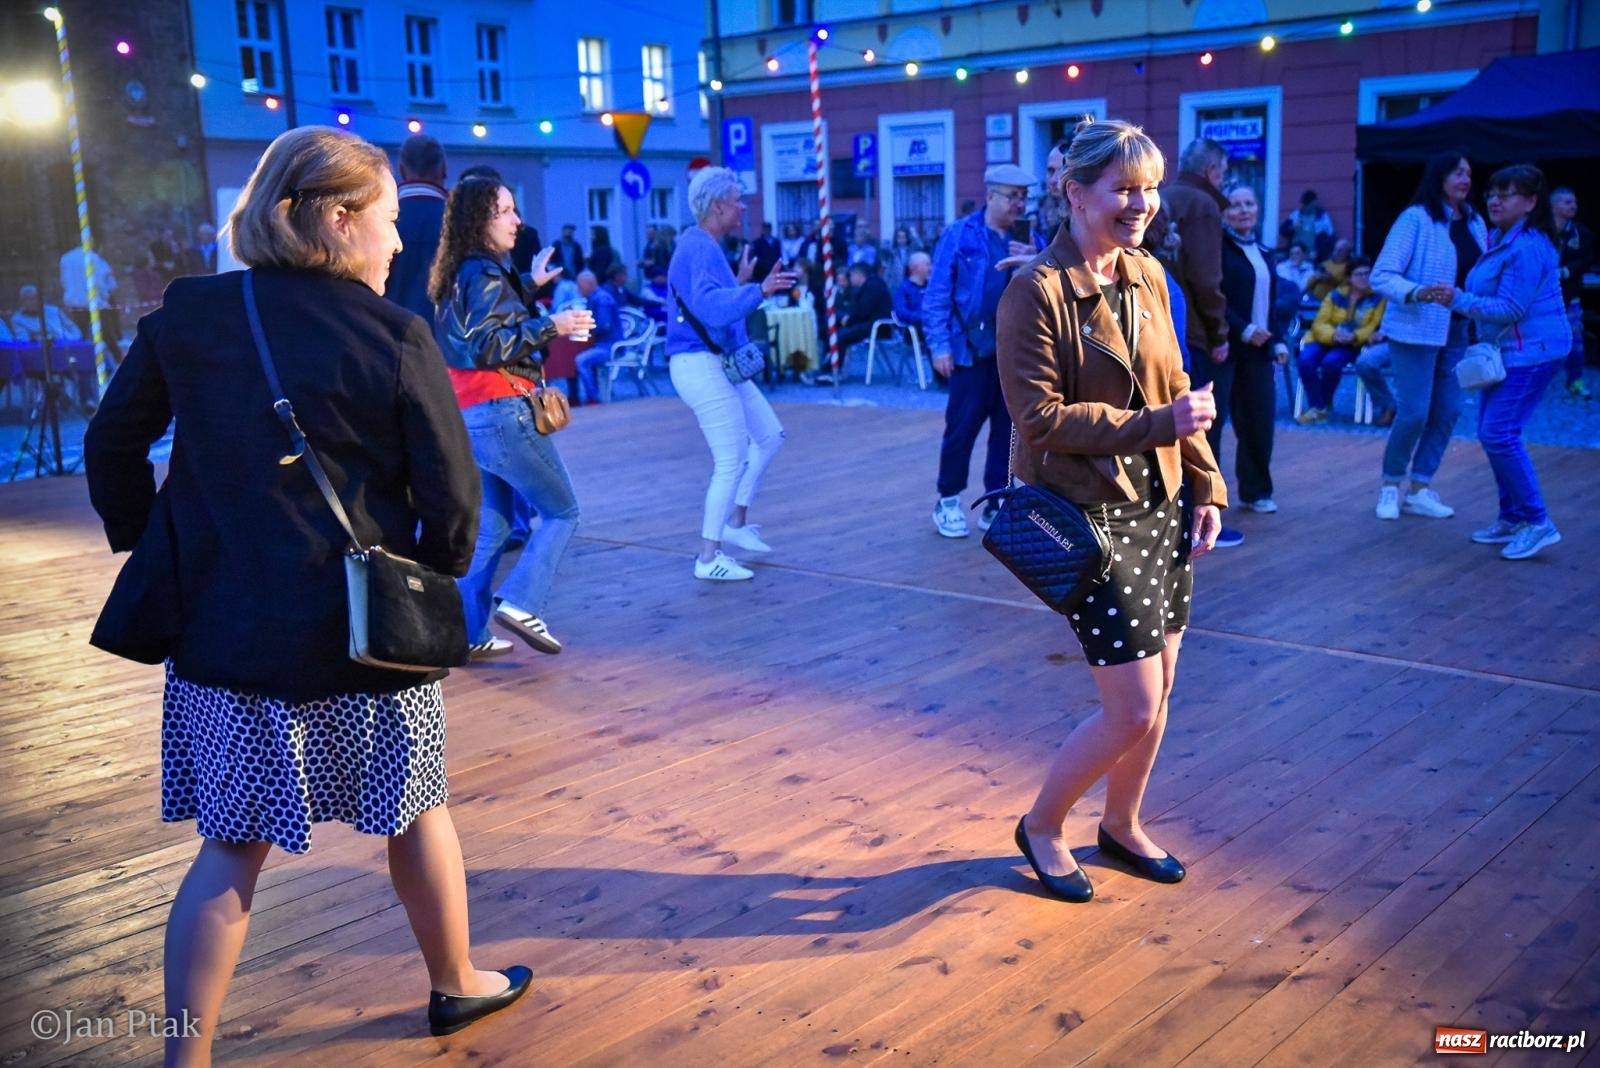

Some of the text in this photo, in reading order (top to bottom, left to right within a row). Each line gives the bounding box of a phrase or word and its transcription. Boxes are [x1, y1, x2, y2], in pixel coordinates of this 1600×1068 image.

[729, 123, 746, 156] P
[859, 136, 872, 155] P
[1027, 509, 1074, 552] MONNARI
